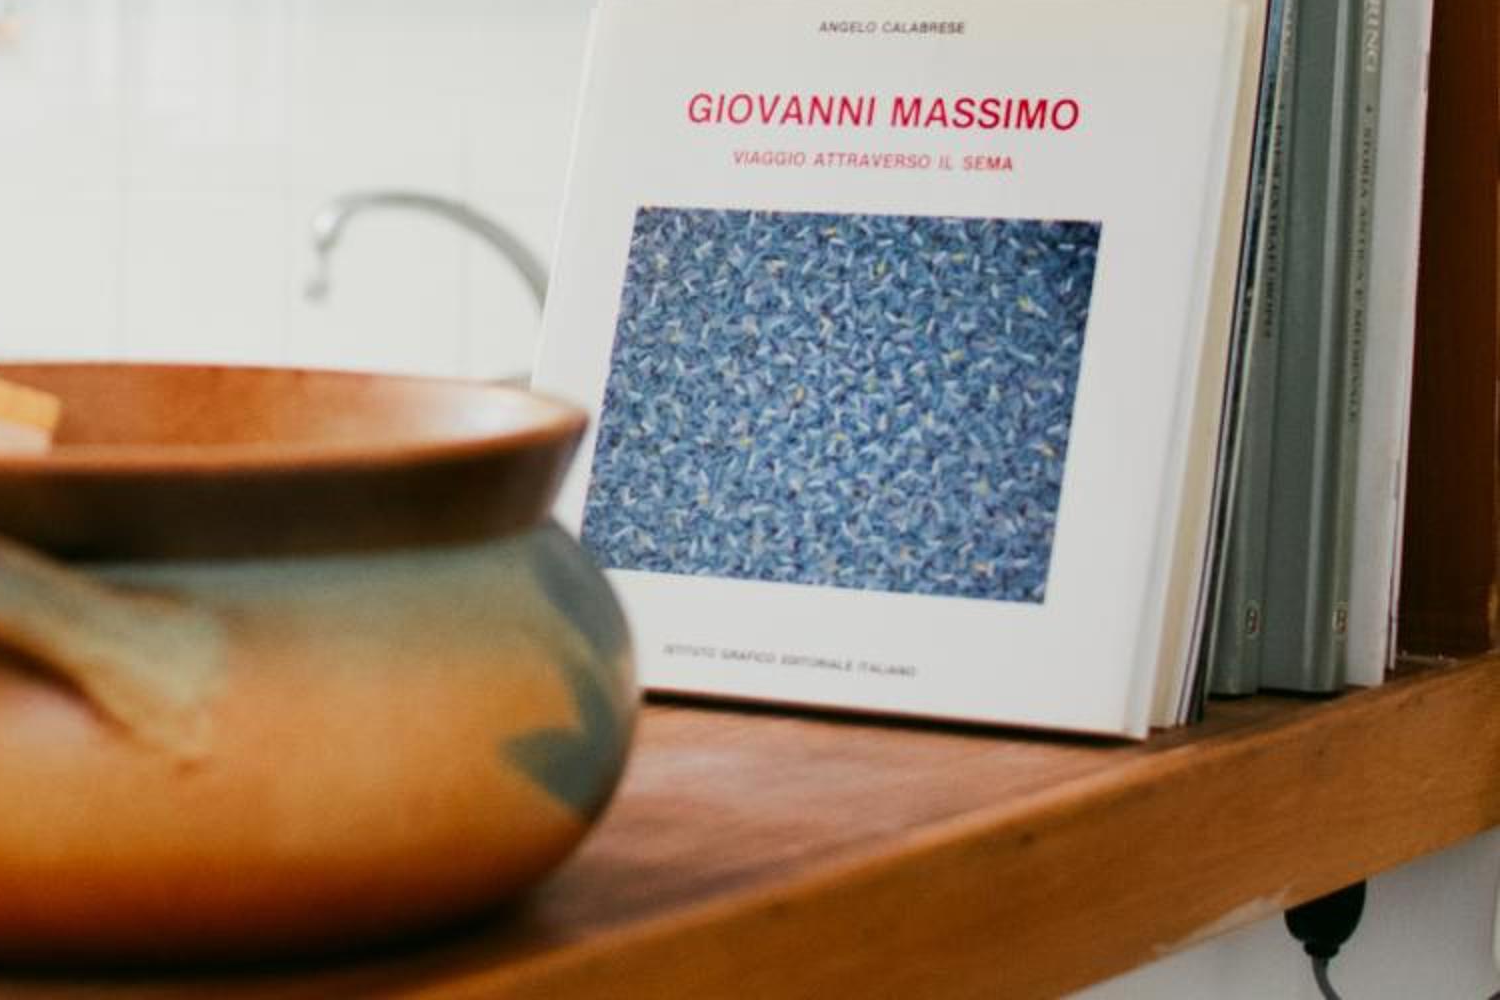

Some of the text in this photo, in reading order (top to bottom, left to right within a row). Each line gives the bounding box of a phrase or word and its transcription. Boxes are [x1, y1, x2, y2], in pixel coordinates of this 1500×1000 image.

[818, 20, 966, 35] ANGELO CALABRESE
[687, 92, 1080, 132] GIOVANNI MASSIMO
[732, 150, 1015, 173] VIAGGIO ATTRAVERSO IL SEMA
[720, 647, 776, 664] GRAFICO
[780, 653, 853, 672] EDITORIALE
[857, 660, 917, 678] ITALIANO
